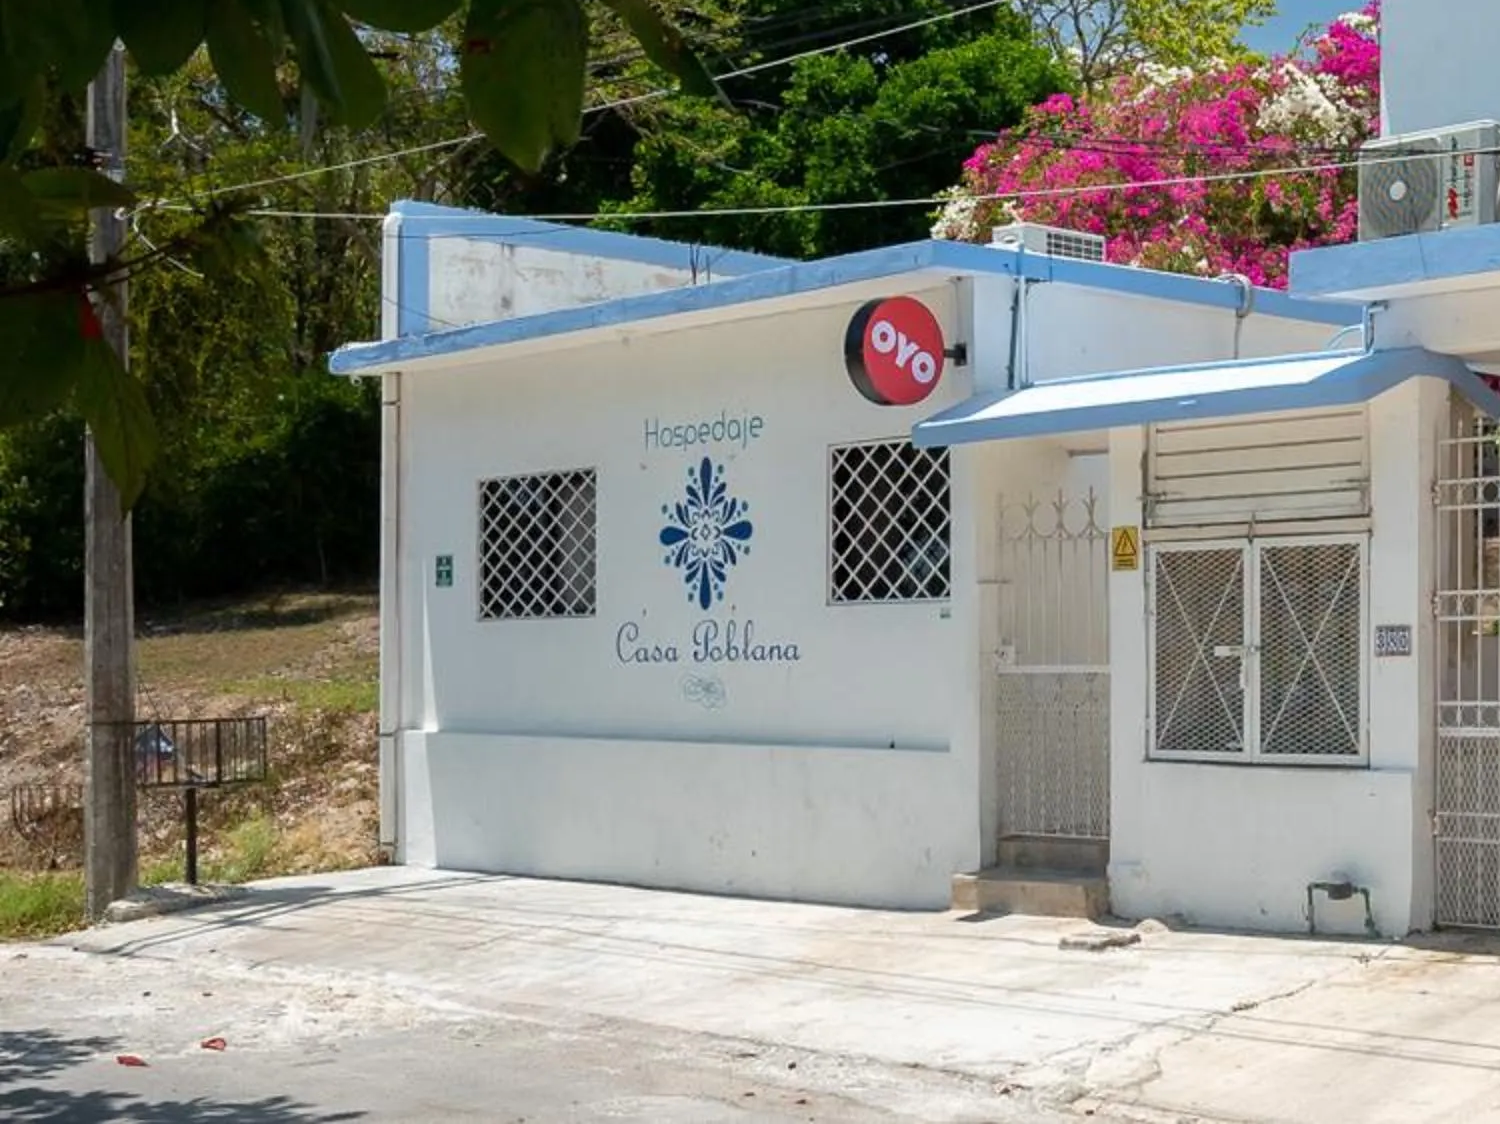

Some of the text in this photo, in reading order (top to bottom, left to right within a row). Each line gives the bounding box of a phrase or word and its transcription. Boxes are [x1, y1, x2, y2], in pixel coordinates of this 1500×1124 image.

[871, 320, 936, 384] OYO
[644, 409, 764, 451] Hospedaje
[615, 618, 800, 664] Casa Poblana
